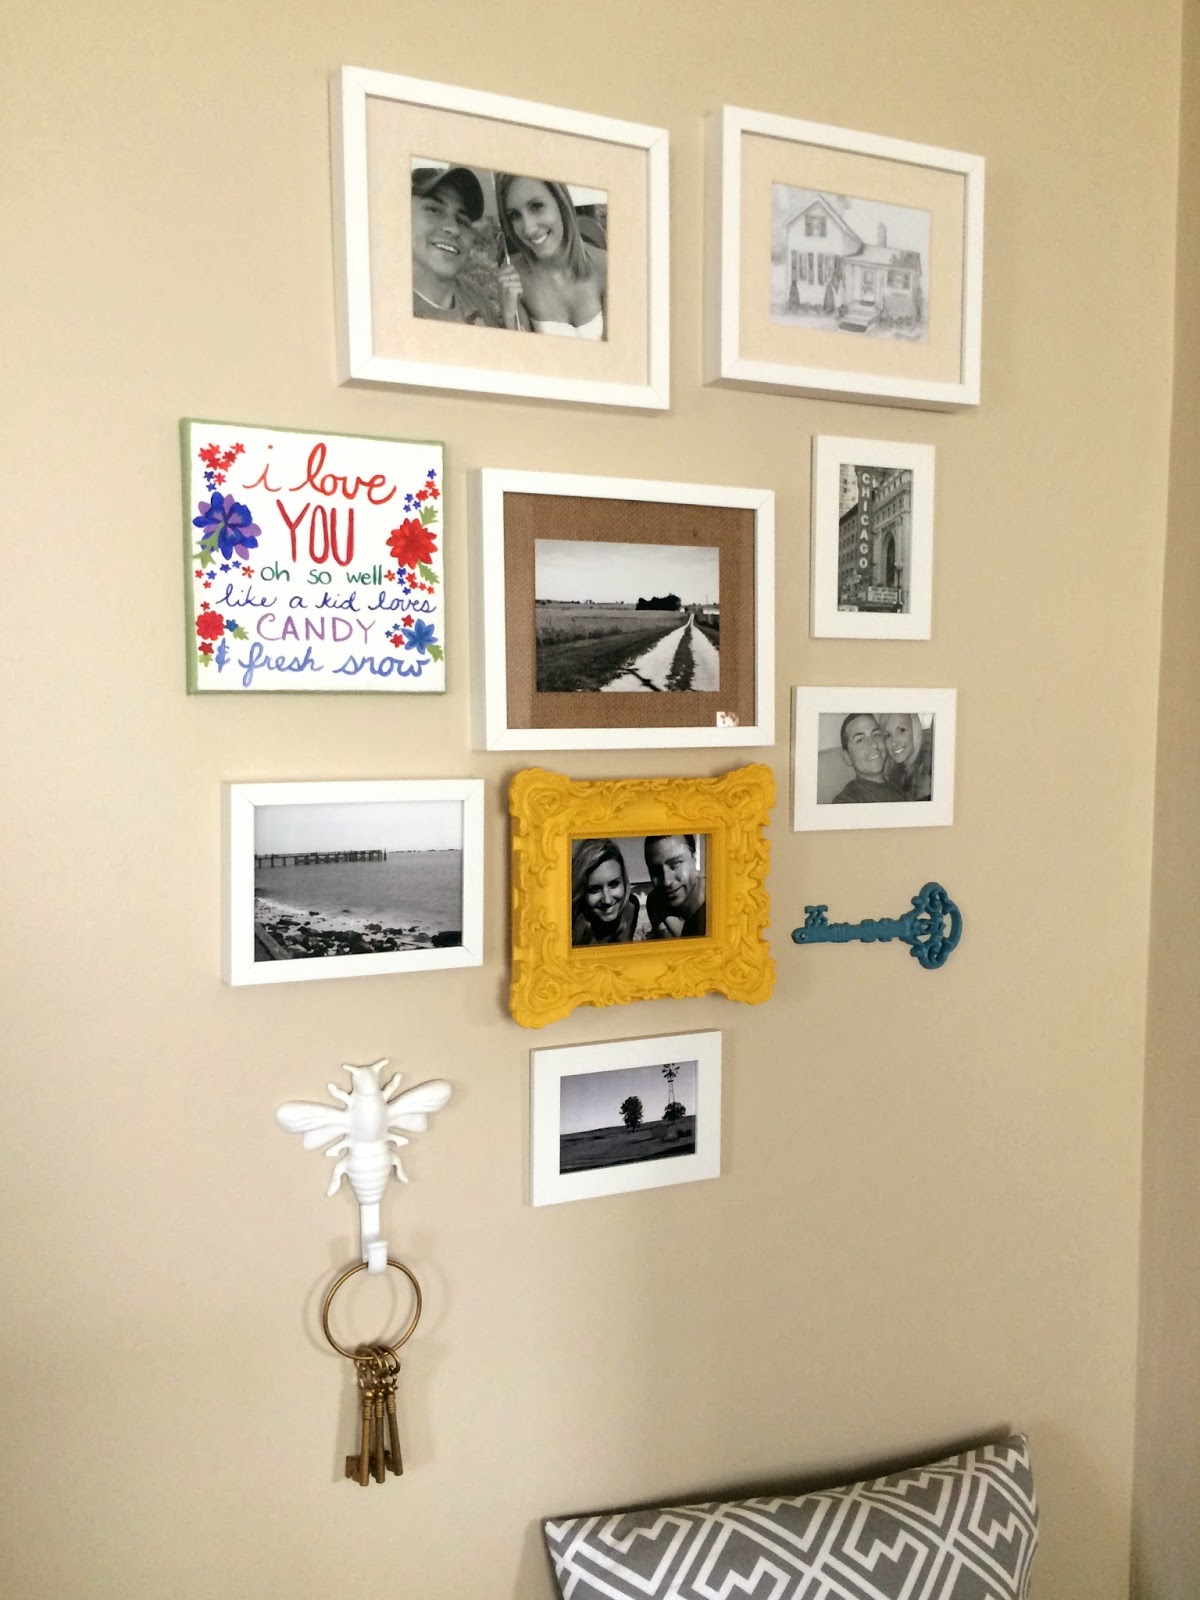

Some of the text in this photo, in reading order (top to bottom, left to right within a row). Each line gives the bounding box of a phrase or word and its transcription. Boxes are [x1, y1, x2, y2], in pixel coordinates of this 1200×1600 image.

[288, 442, 397, 505] love
[275, 499, 355, 567] YOU
[859, 472, 871, 569] CHICAGO
[260, 561, 382, 585] oh so well
[215, 583, 437, 613] like a kid loves
[256, 612, 376, 644] CANDY
[237, 642, 324, 688] fresh
[332, 655, 431, 677] snow
